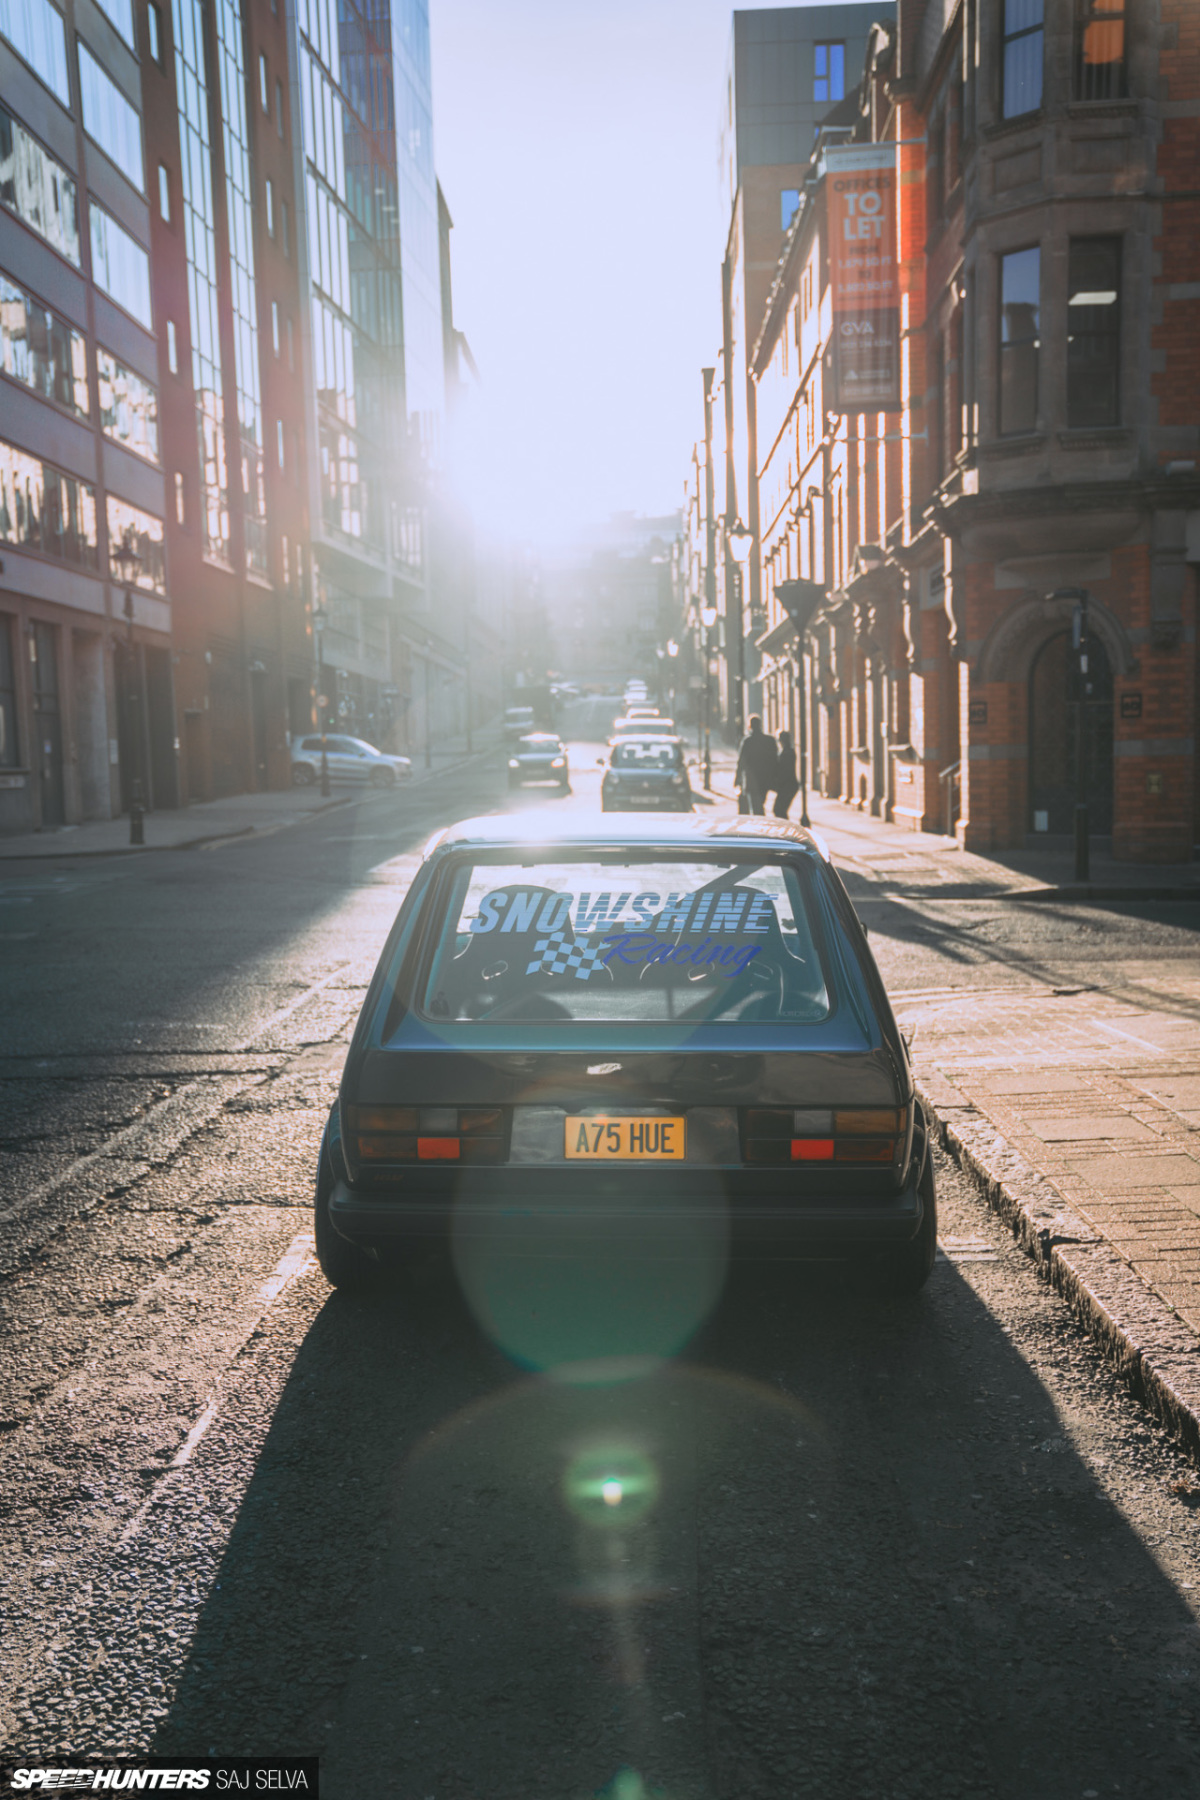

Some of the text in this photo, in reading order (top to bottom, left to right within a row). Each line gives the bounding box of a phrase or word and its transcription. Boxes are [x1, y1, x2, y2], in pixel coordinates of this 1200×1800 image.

[834, 175, 891, 192] OFFICES
[844, 191, 882, 215] TO
[843, 215, 885, 240] LET
[866, 256, 880, 267] SQ
[881, 255, 892, 266] FT
[840, 320, 875, 336] GVA
[469, 892, 779, 934] SNOWSHINE
[602, 934, 763, 979] Racing
[575, 1122, 674, 1153] A75 HUE
